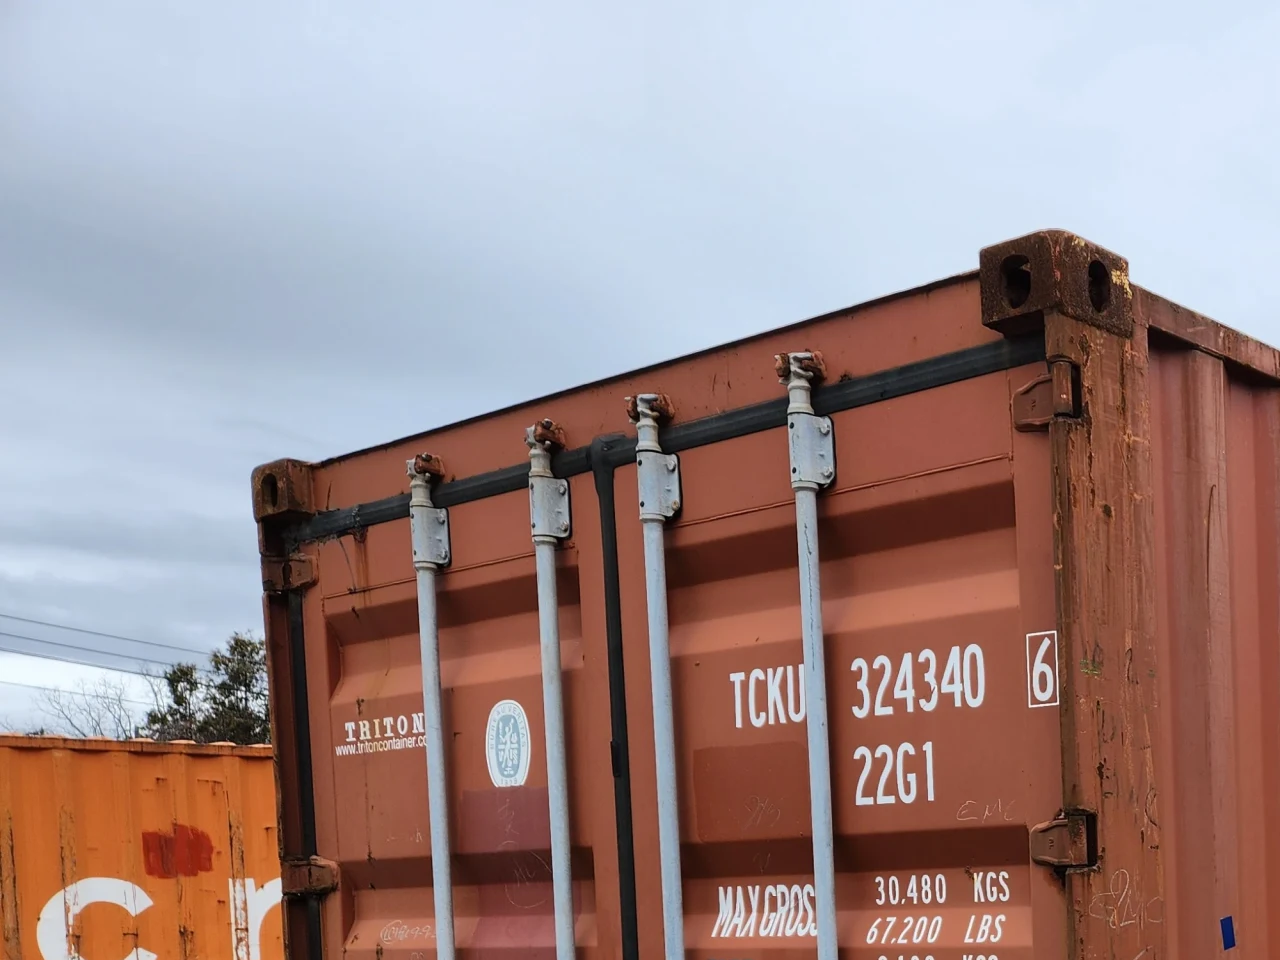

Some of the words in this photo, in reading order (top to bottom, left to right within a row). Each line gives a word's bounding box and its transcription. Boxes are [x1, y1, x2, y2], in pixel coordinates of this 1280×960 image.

[729, 663, 807, 729] TCKU
[850, 643, 986, 719] 324340
[1031, 636, 1054, 703] 6
[344, 712, 425, 742] TRITON
[852, 741, 935, 806] 22G1
[710, 886, 761, 938] MAX
[758, 884, 818, 938] GROS
[874, 873, 948, 906] 30,480
[972, 871, 1011, 903] KGS
[865, 916, 943, 945] 67,200
[963, 914, 1007, 944] LBS
